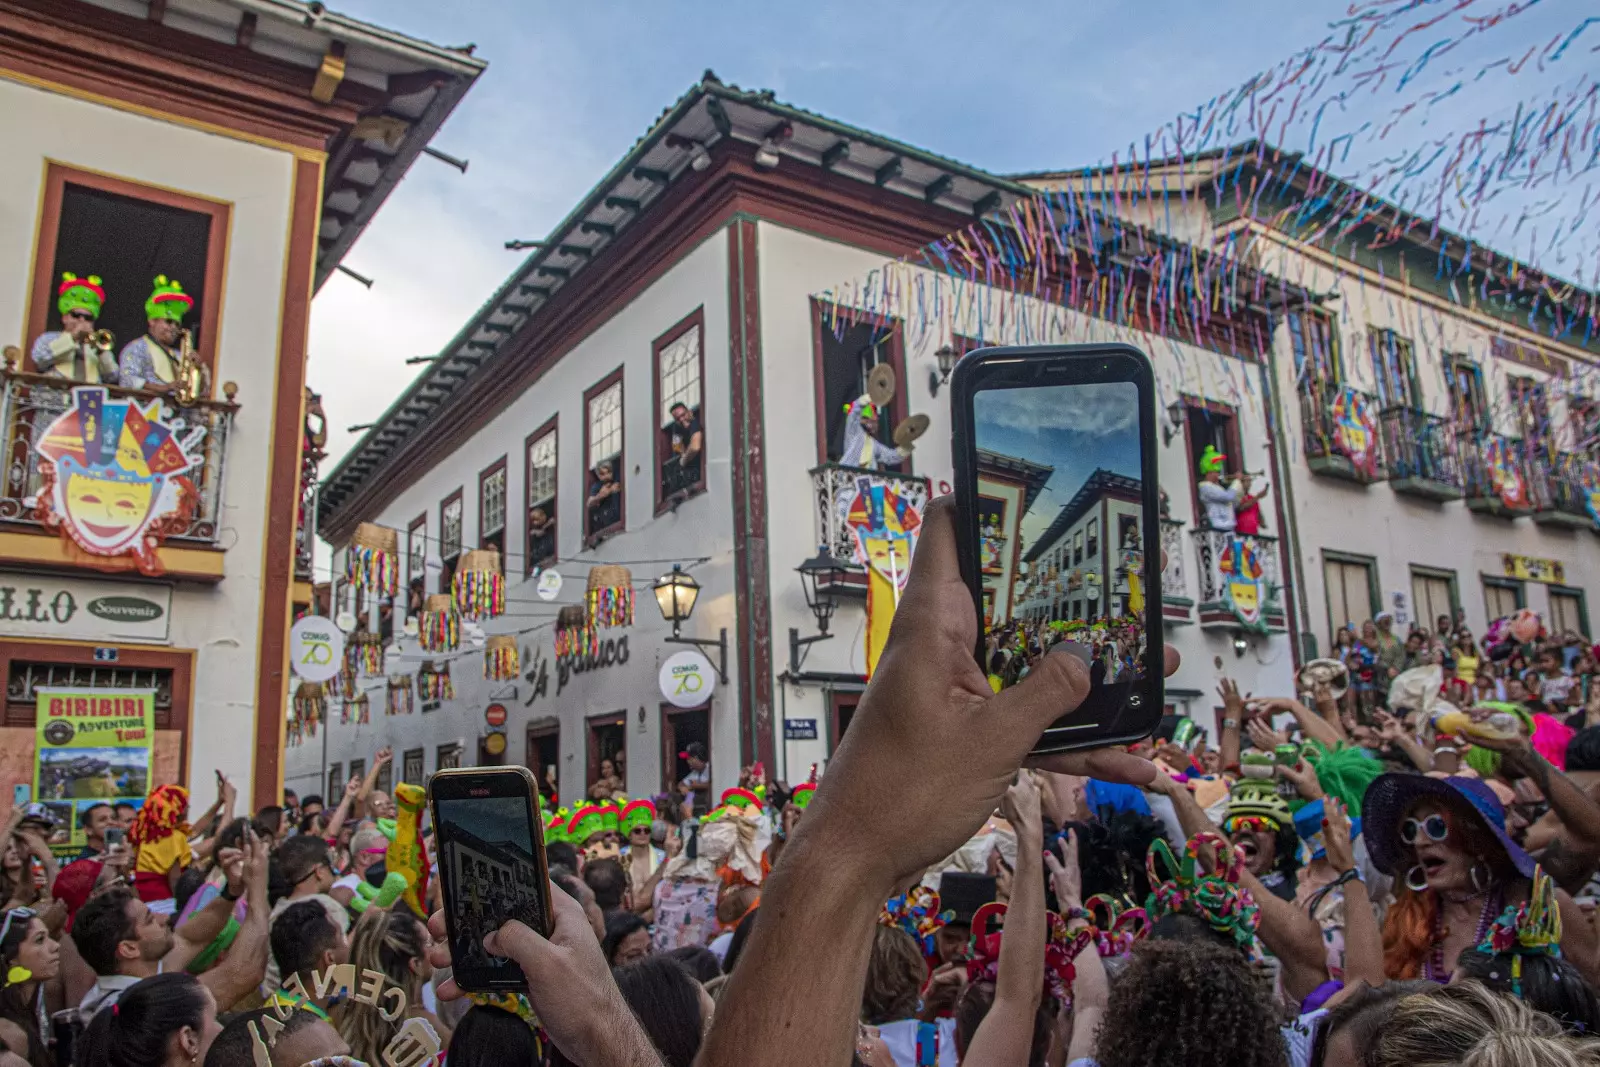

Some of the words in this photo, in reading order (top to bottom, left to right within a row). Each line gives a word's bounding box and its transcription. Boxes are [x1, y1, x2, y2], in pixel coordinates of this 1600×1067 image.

[95, 598, 156, 617] Souvenir
[301, 640, 333, 665] 70
[672, 672, 703, 696] 70
[48, 697, 145, 717] BIRIBIRI
